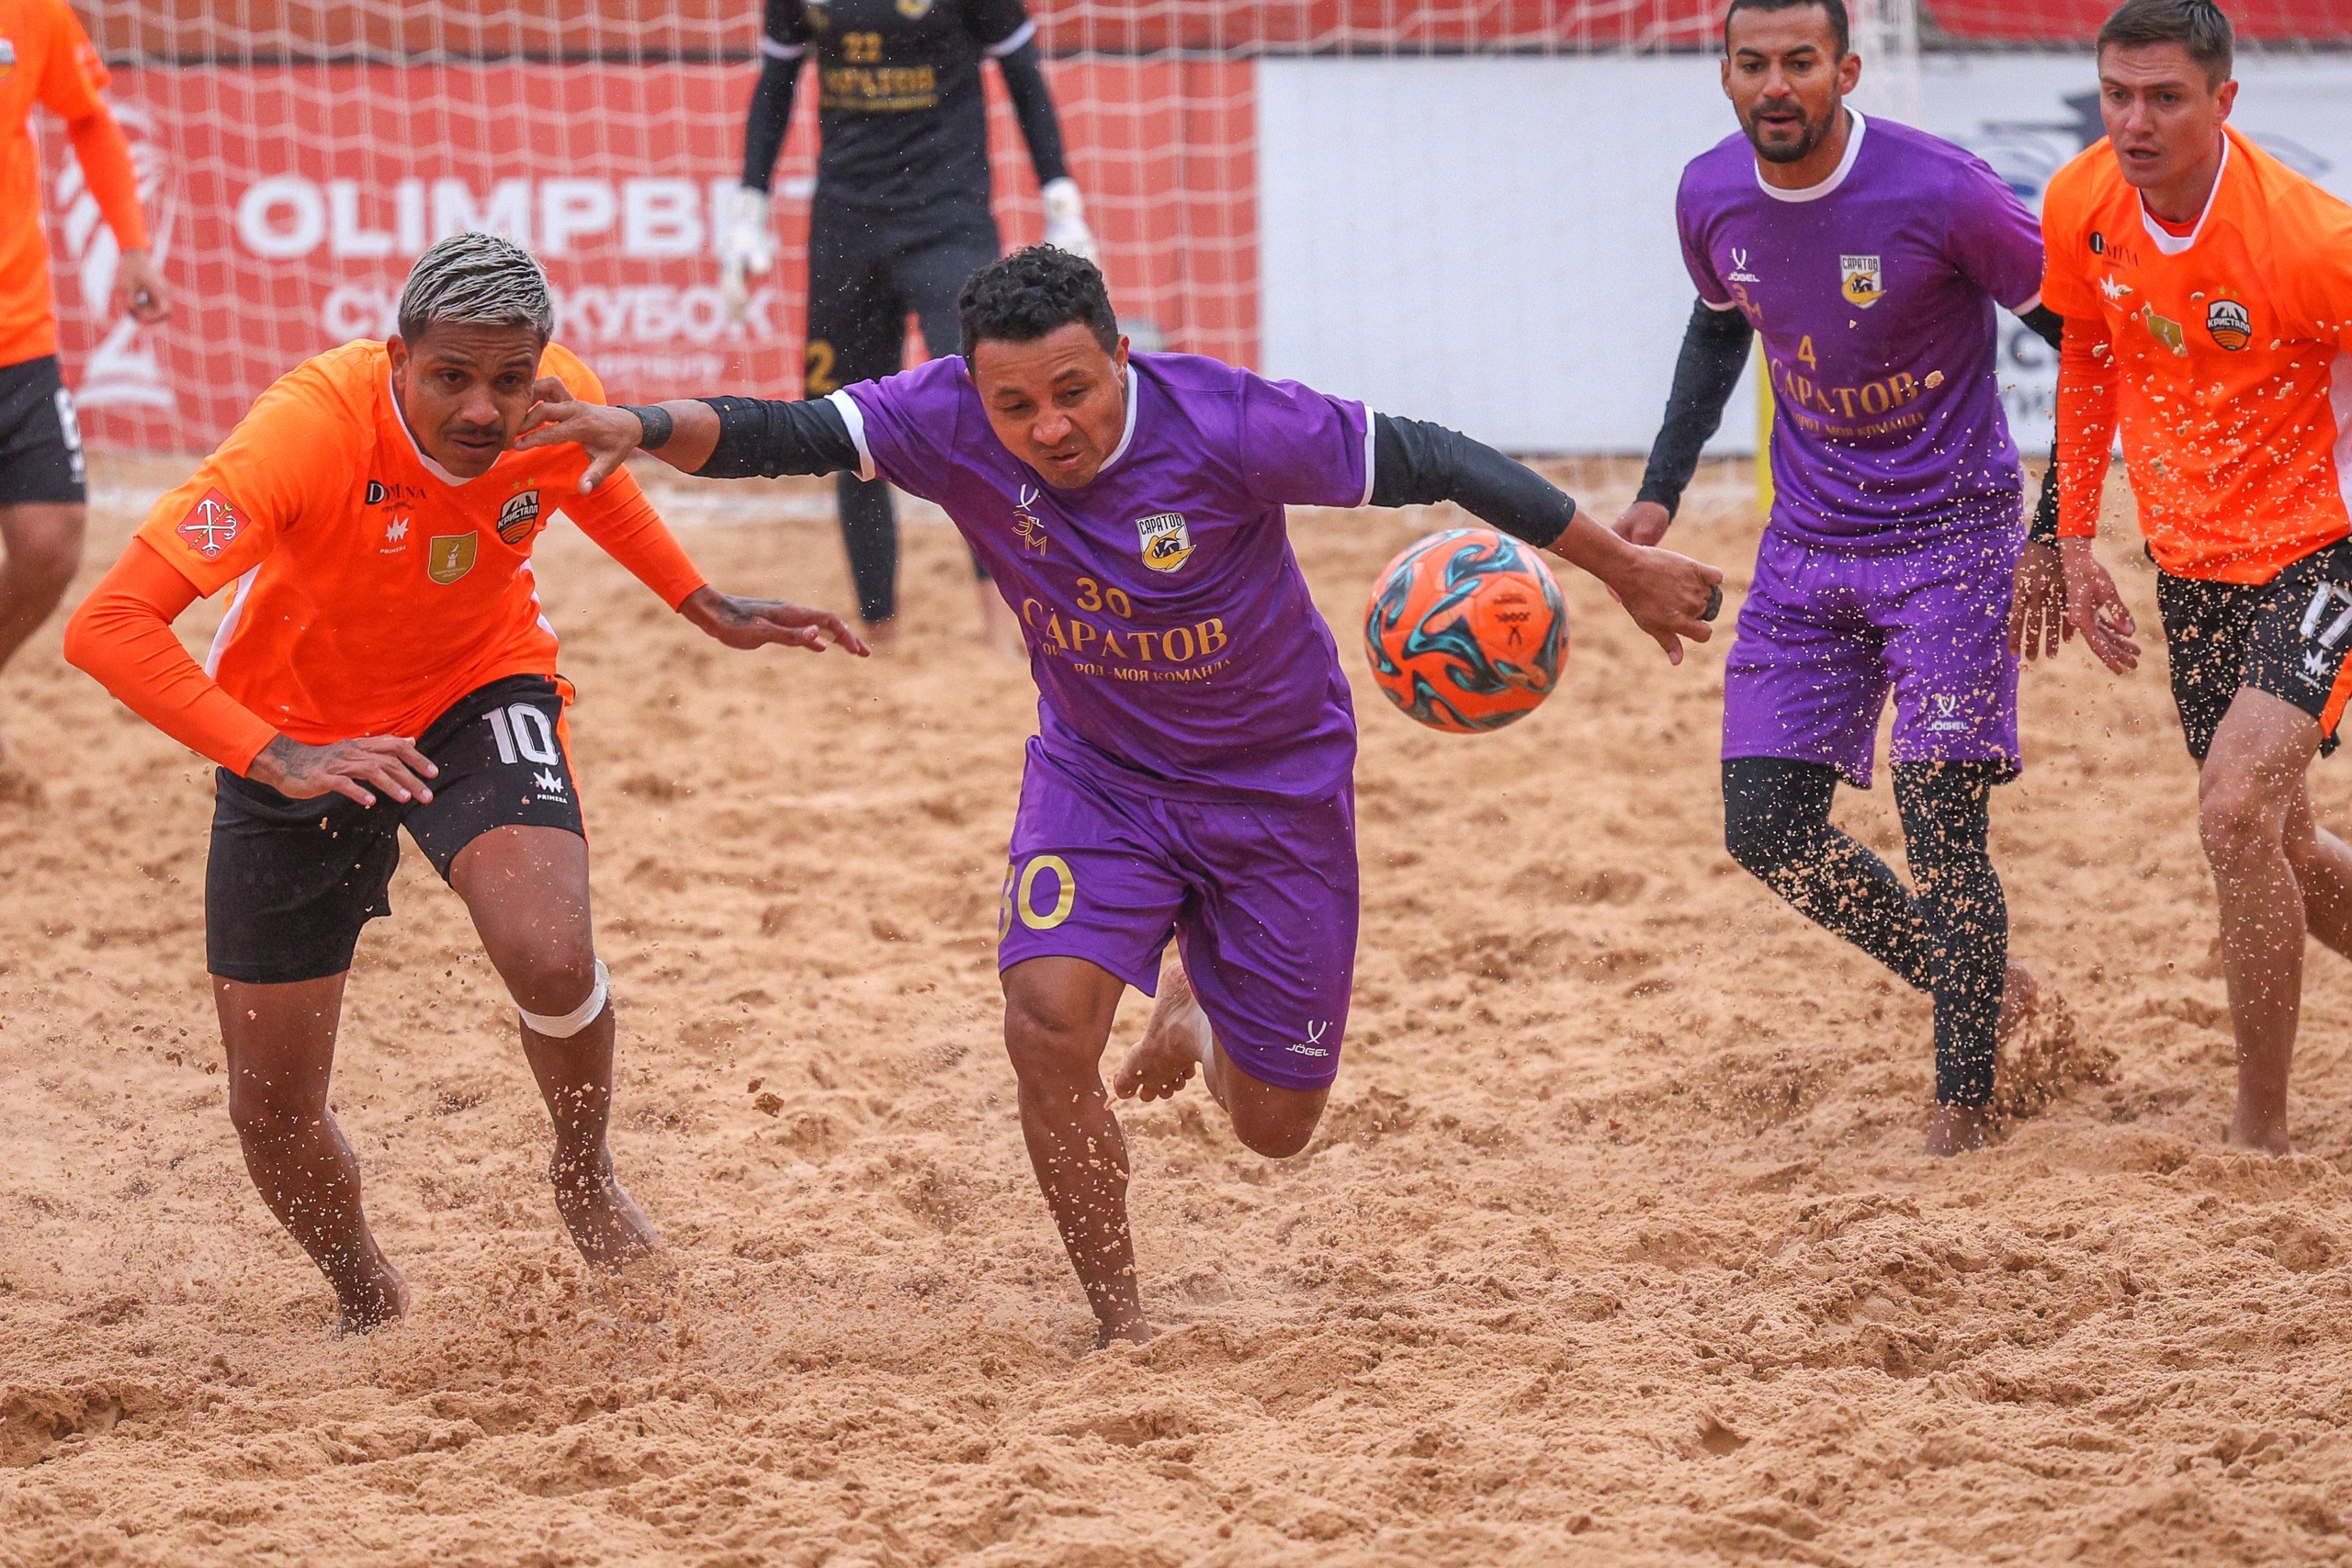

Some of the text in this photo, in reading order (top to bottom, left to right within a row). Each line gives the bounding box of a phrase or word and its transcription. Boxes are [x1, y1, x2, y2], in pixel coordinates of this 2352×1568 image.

[1841, 257, 1879, 271] САРАТОВ
[323, 284, 775, 343] СУКУБОК
[1797, 334, 1817, 371] 4
[1770, 358, 1919, 419] САРАТОВ
[497, 504, 538, 530] КРИСТАЛЛ
[1138, 513, 1182, 536] САРАТОВ
[1076, 577, 1132, 619] 30
[1023, 598, 1227, 661] САРАТОВ
[1114, 667, 1148, 682] МОЯ
[481, 702, 559, 766] 10
[537, 794, 568, 805] PRIMERA
[1284, 1043, 1329, 1056] JÖGEL
